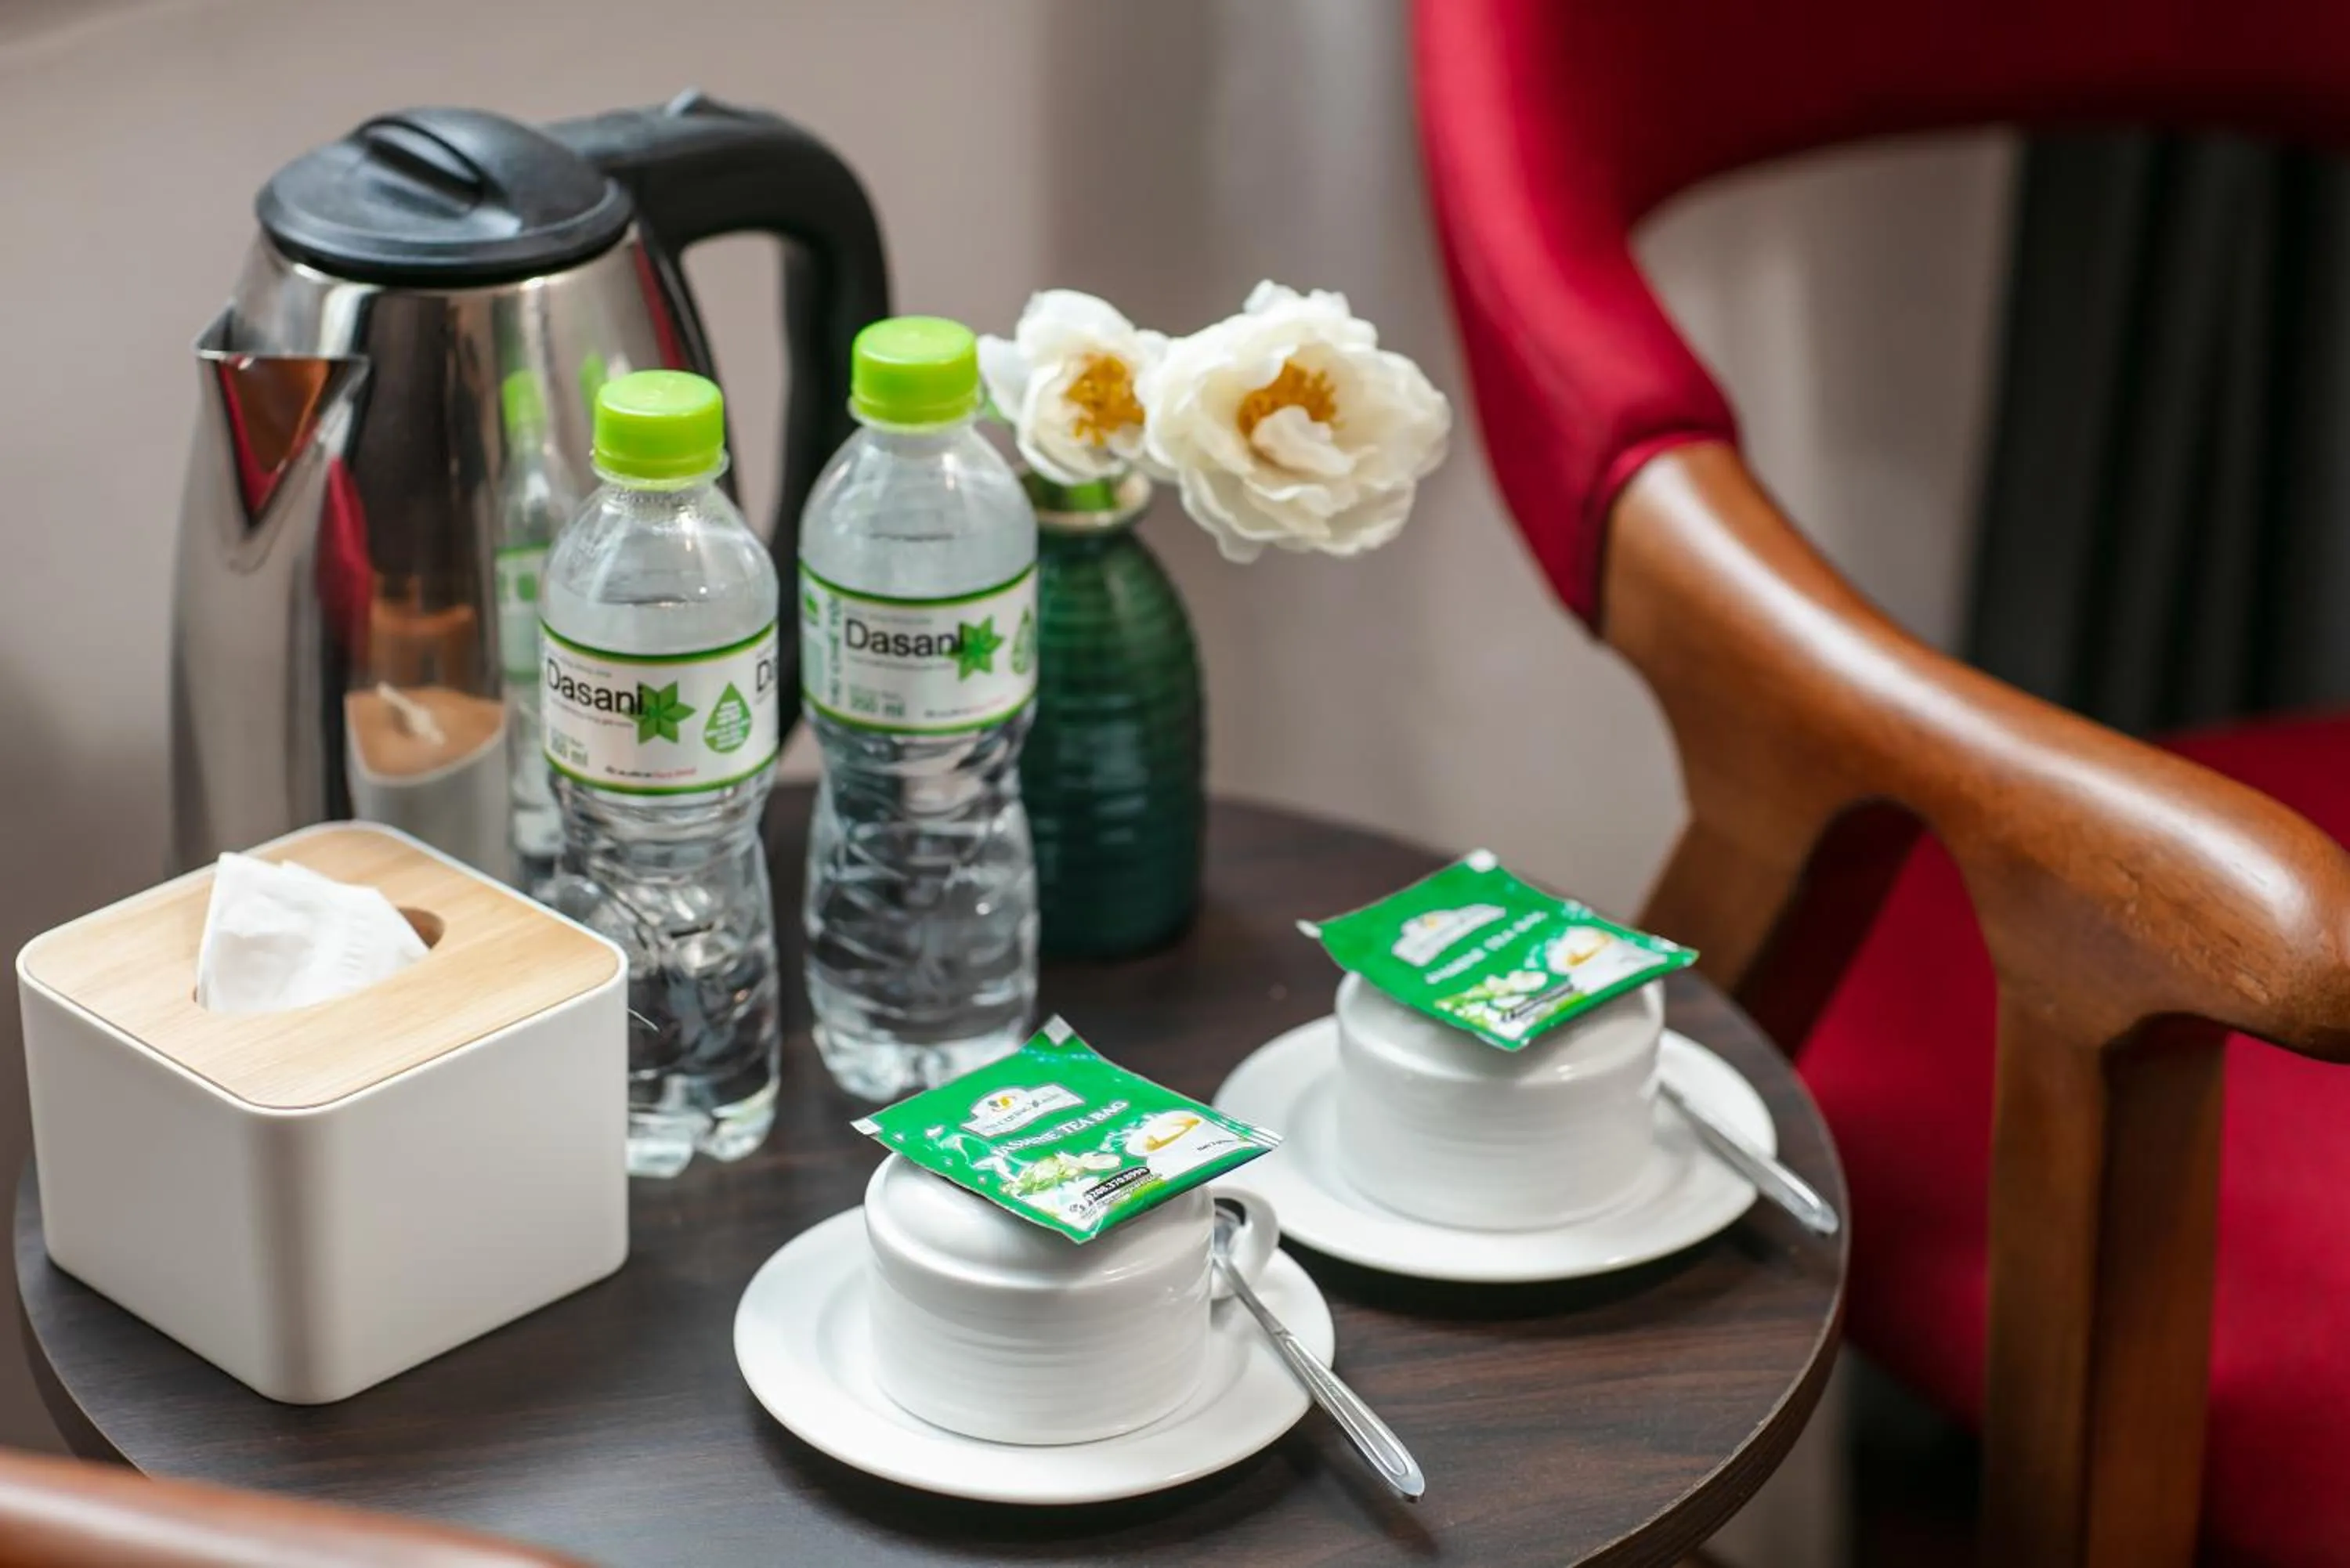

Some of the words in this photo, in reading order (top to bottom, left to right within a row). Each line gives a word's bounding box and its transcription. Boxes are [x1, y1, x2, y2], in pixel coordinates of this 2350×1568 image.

[844, 617, 965, 659] Dasani
[548, 657, 643, 715] Dasani
[1058, 1117, 1095, 1134] TEA
[1089, 1100, 1129, 1124] BAG
